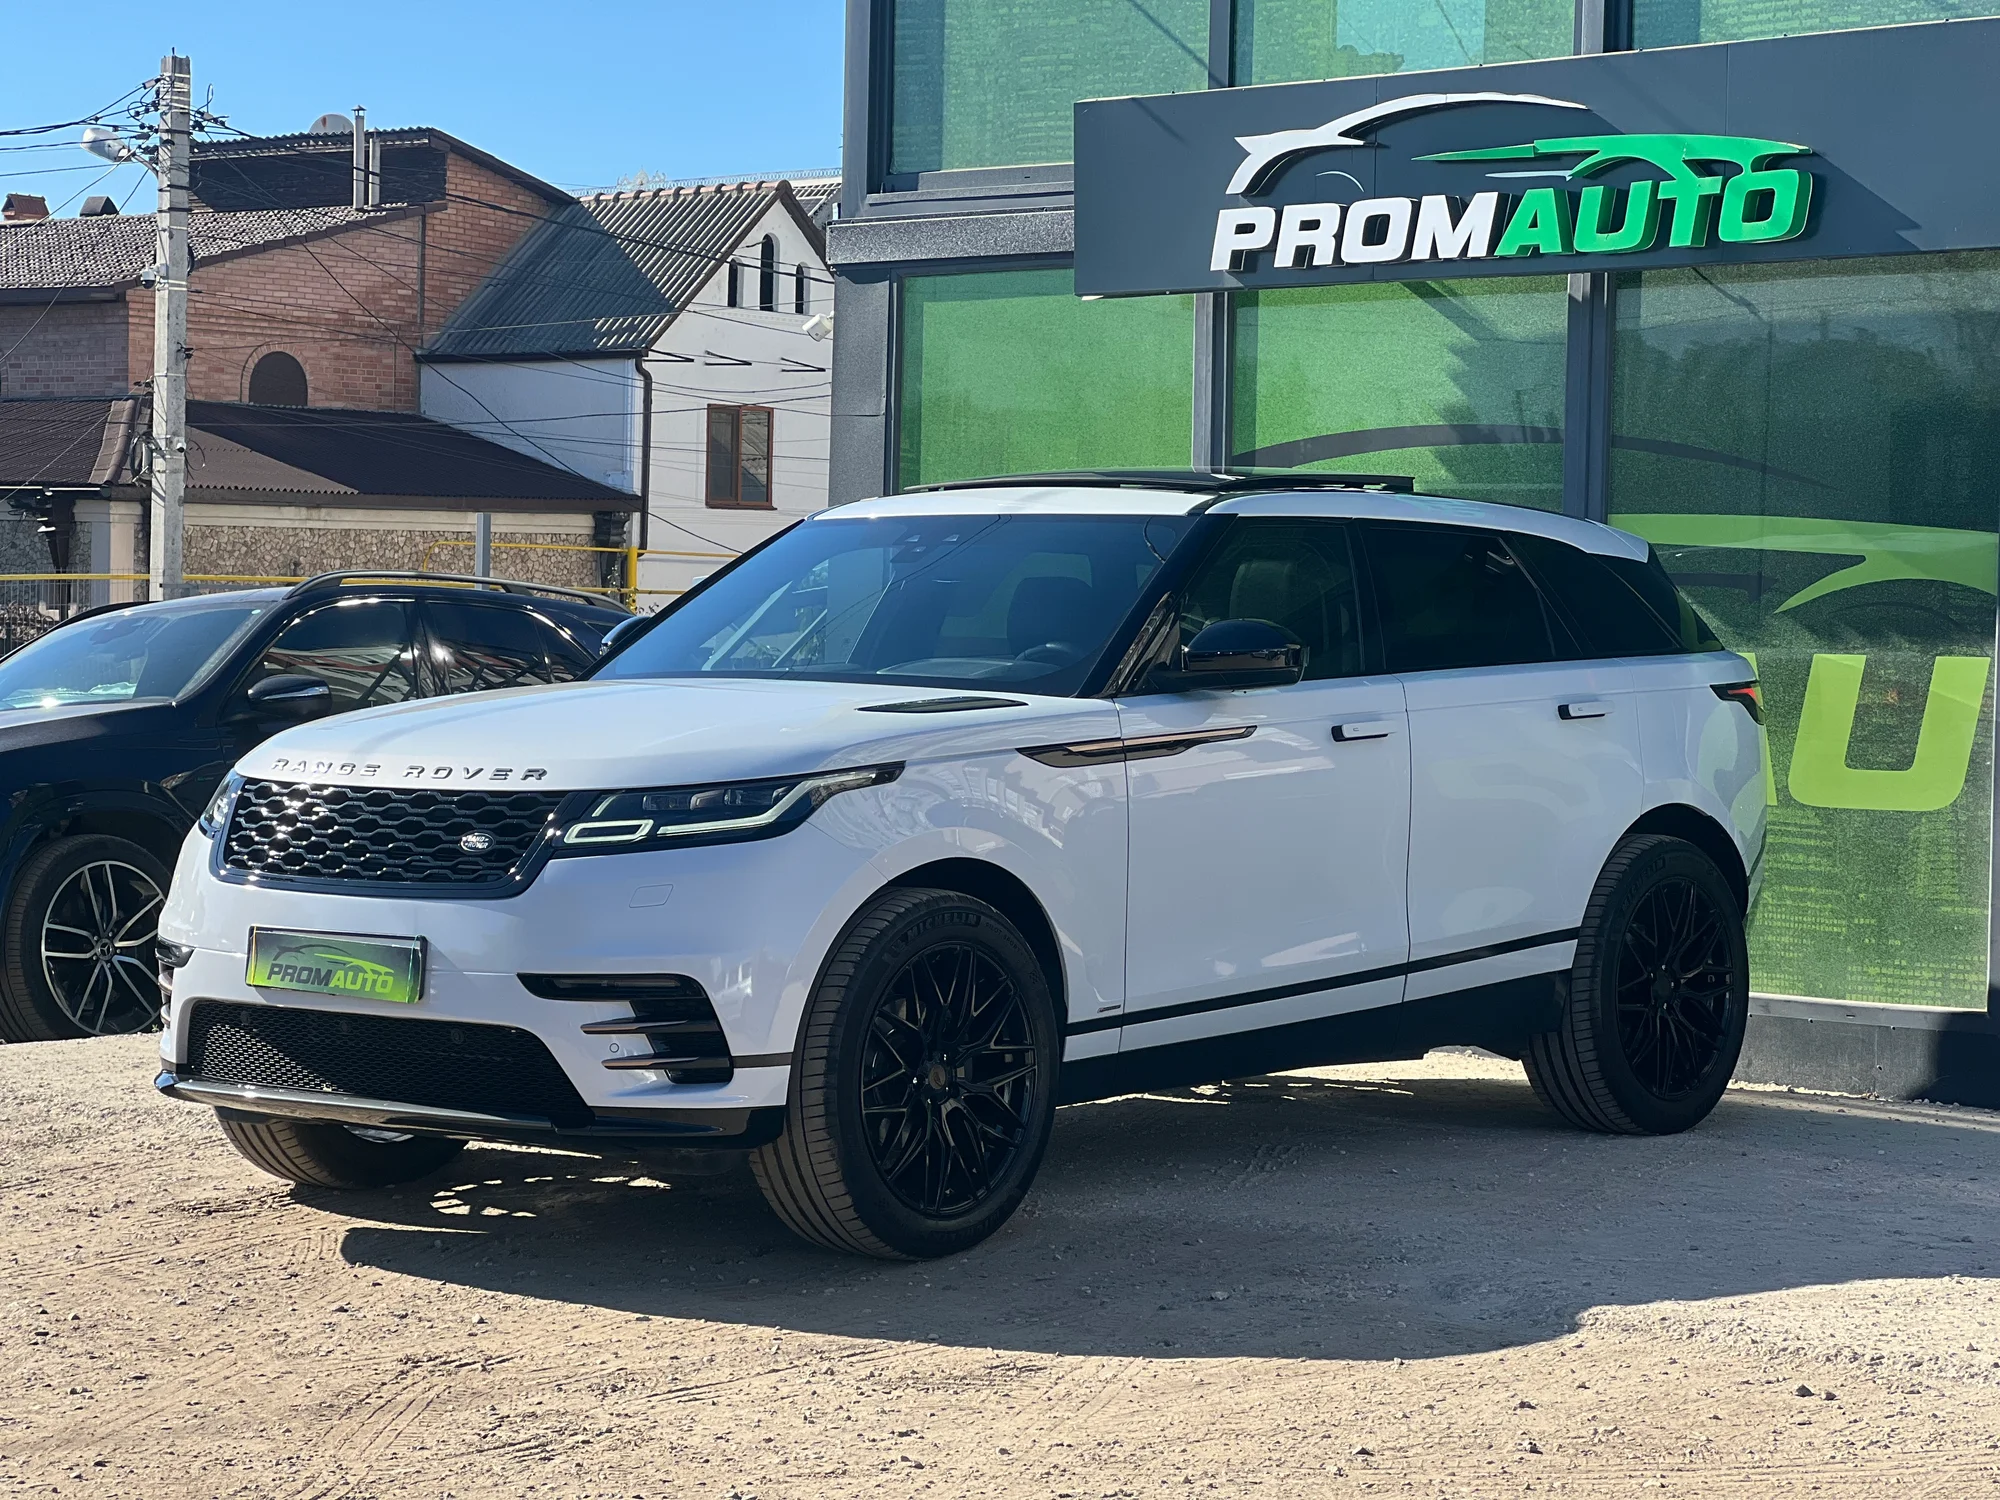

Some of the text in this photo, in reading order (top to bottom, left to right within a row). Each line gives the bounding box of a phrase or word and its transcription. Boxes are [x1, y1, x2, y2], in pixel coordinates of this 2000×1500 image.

[1209, 168, 1812, 272] PROMAUTO
[271, 758, 547, 782] RANGE ROVER
[907, 913, 978, 940] MICHELIN
[267, 963, 395, 994] PROMAUTO
